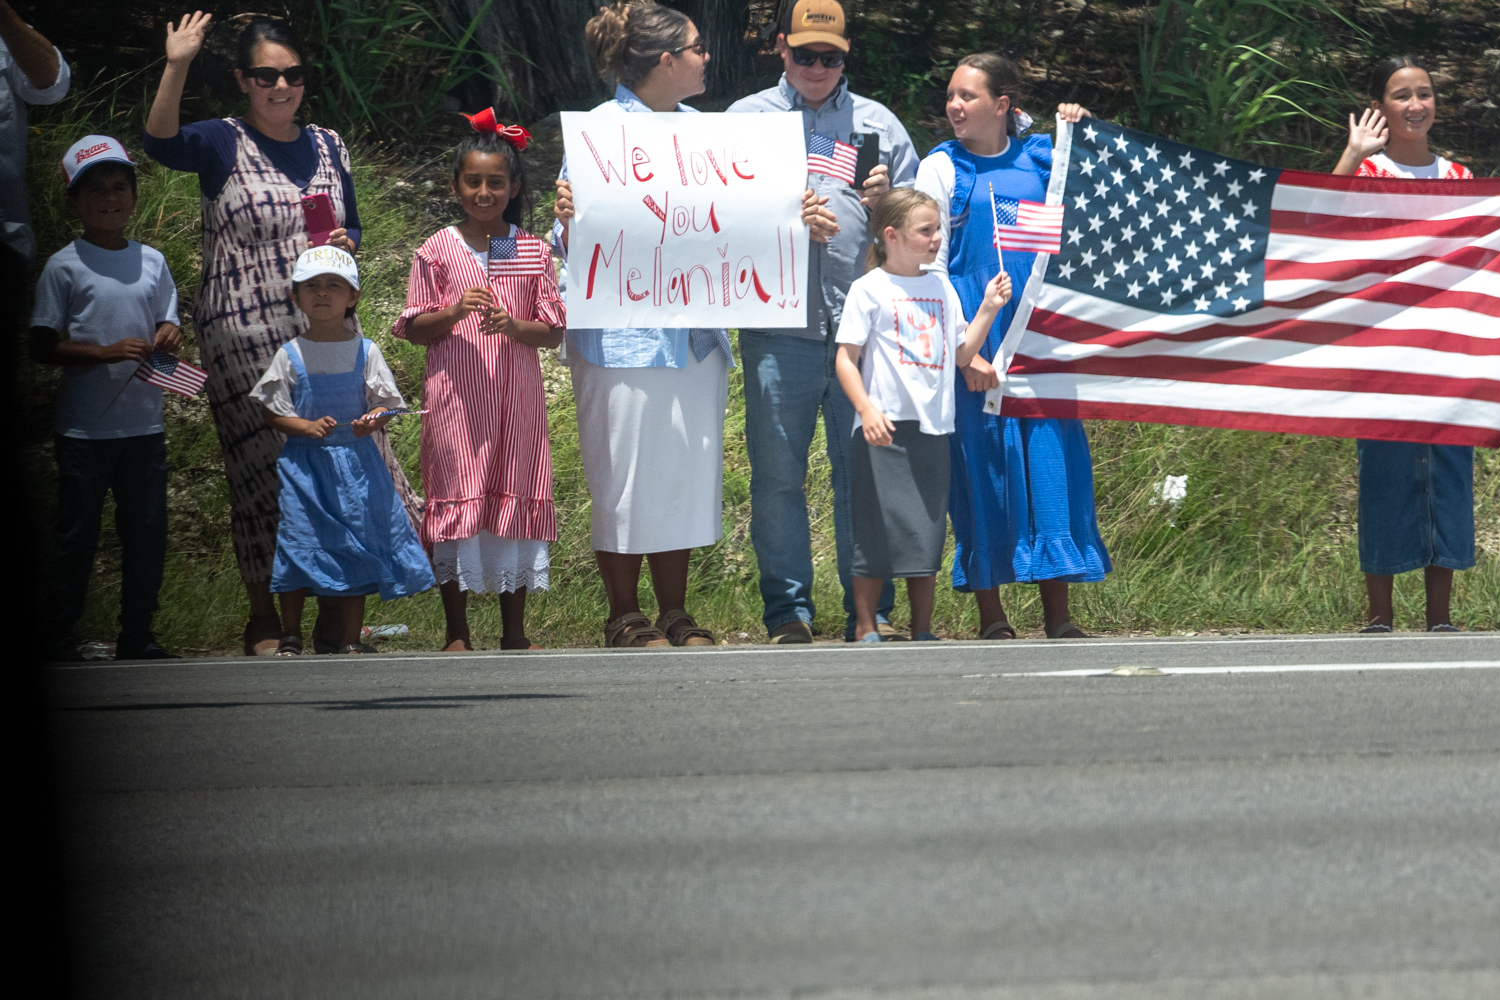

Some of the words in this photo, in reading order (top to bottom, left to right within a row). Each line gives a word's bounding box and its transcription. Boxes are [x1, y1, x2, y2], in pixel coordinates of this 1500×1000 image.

[75, 142, 111, 165] Brave
[582, 124, 654, 186] We
[673, 133, 755, 186] love
[305, 249, 352, 268] TRUMP
[319, 260, 342, 269] 2024
